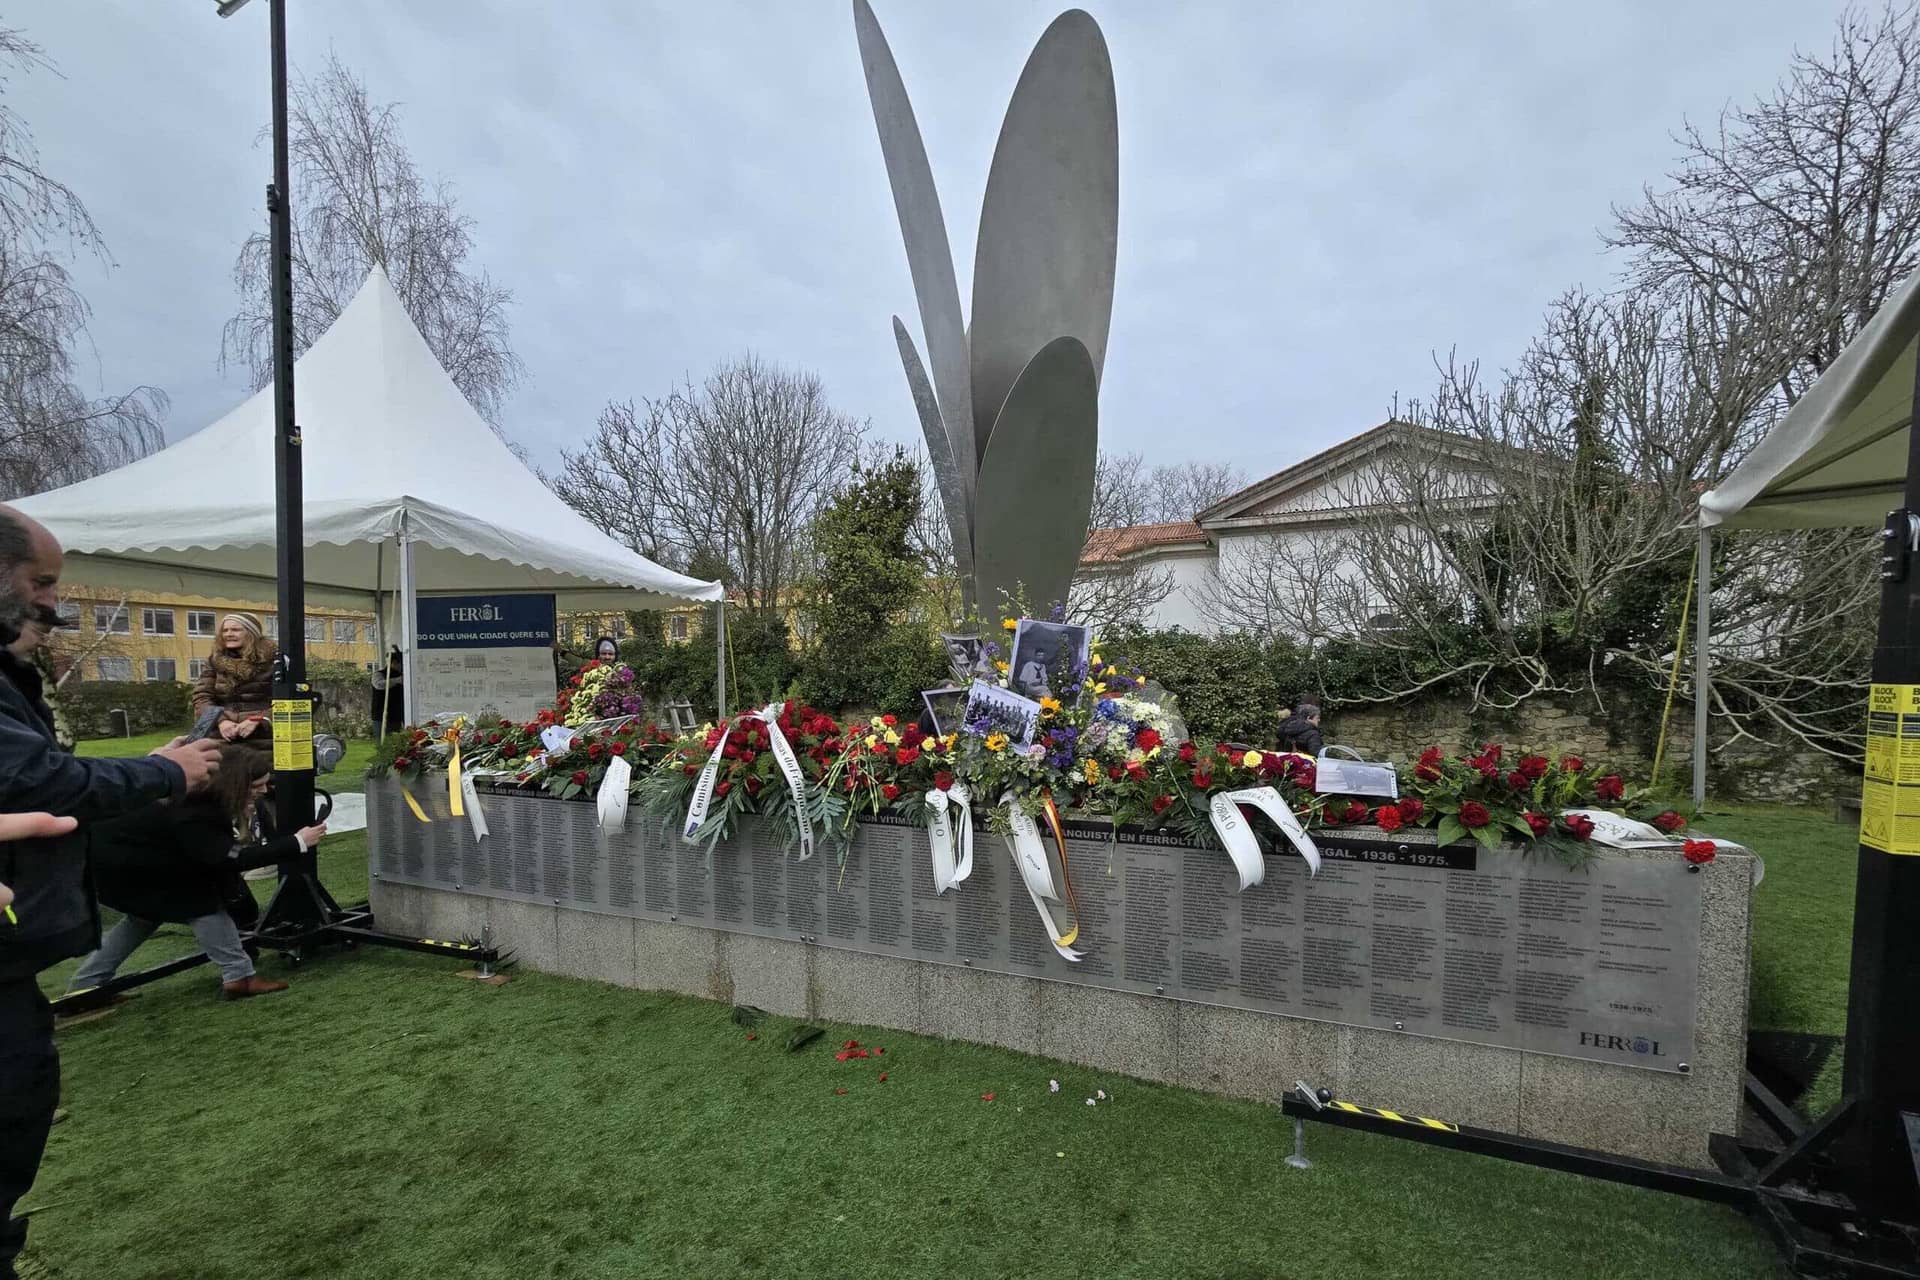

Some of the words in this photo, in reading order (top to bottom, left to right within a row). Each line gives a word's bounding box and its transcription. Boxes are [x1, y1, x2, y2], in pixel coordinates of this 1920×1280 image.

[437, 633, 456, 641] QUE
[456, 632, 478, 640] UNHA
[480, 631, 508, 640] CIDADE
[509, 631, 532, 640] QUERE
[1120, 834, 1136, 842] EN
[1362, 850, 1396, 862] 1936
[1409, 854, 1449, 866] 1975.
